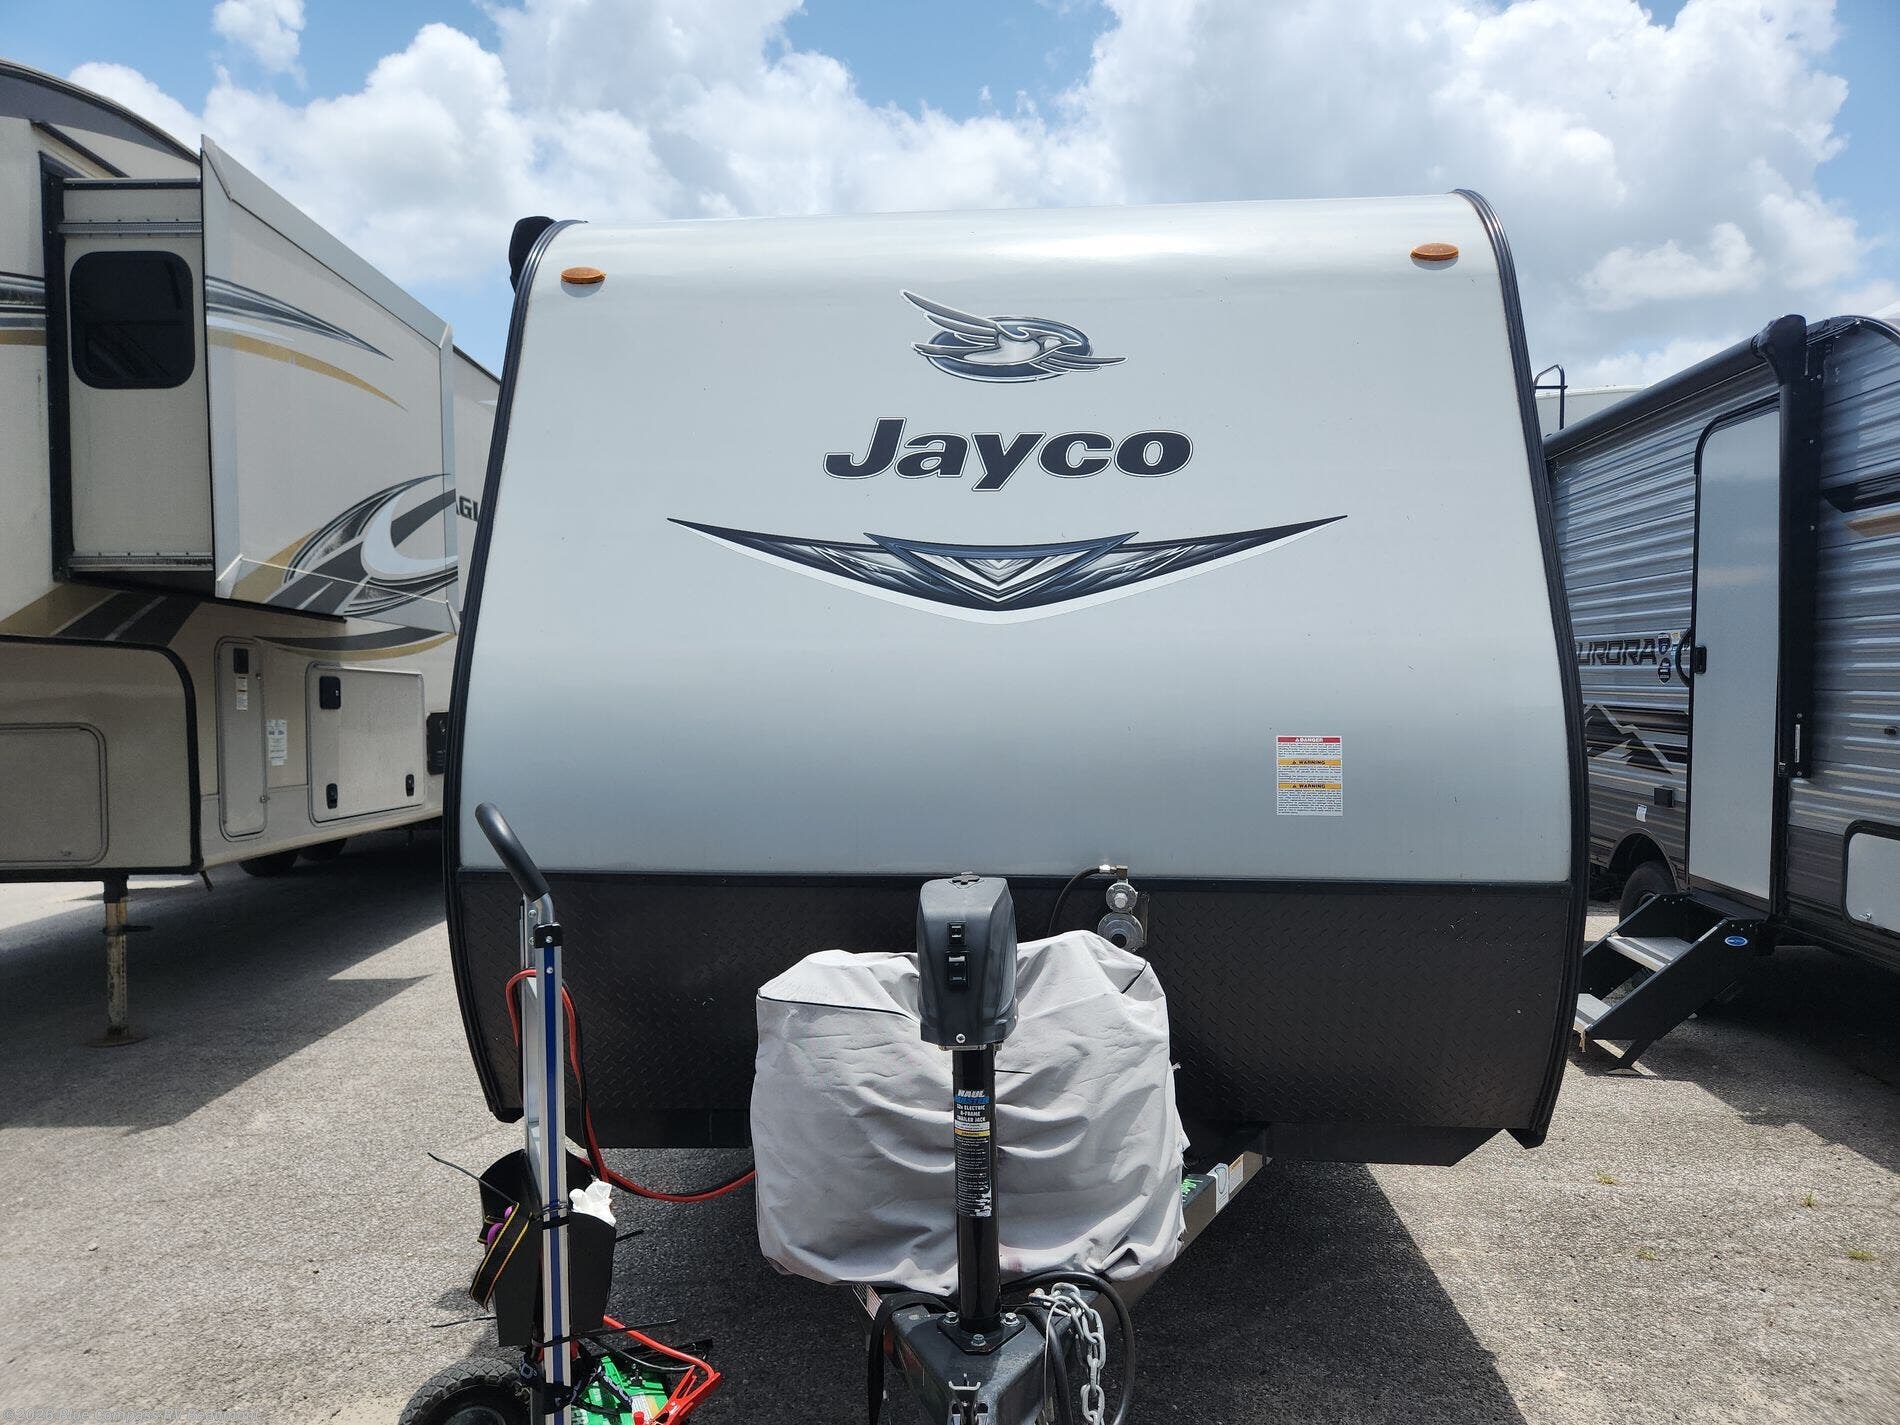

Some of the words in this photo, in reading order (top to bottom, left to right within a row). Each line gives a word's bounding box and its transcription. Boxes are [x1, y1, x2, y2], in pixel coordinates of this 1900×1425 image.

[823, 416, 1193, 491] Jayco
[1575, 639, 1657, 666] URORA
[958, 1089, 985, 1097] HAUL
